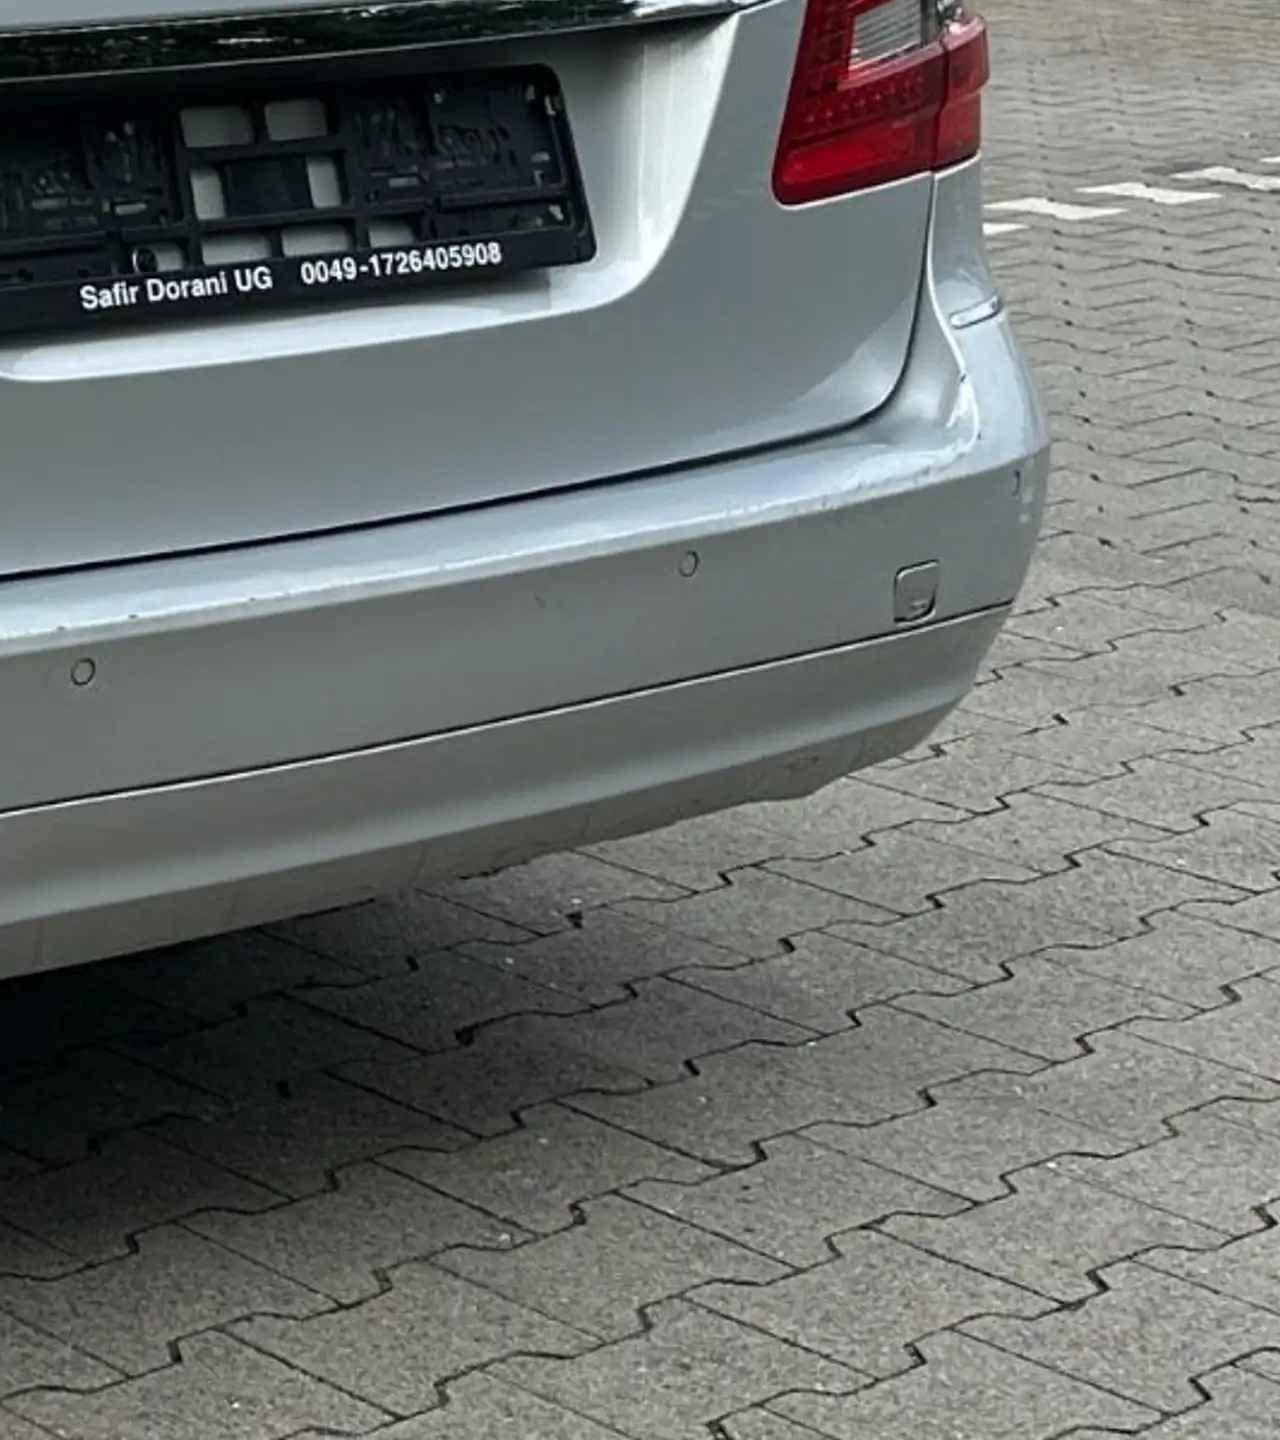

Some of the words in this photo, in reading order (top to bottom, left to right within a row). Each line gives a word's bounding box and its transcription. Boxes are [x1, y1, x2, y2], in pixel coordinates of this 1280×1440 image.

[80, 281, 138, 310] Safir
[146, 271, 227, 302] Dorani
[234, 266, 273, 292] UG
[300, 242, 502, 285] 0049-1726405908
